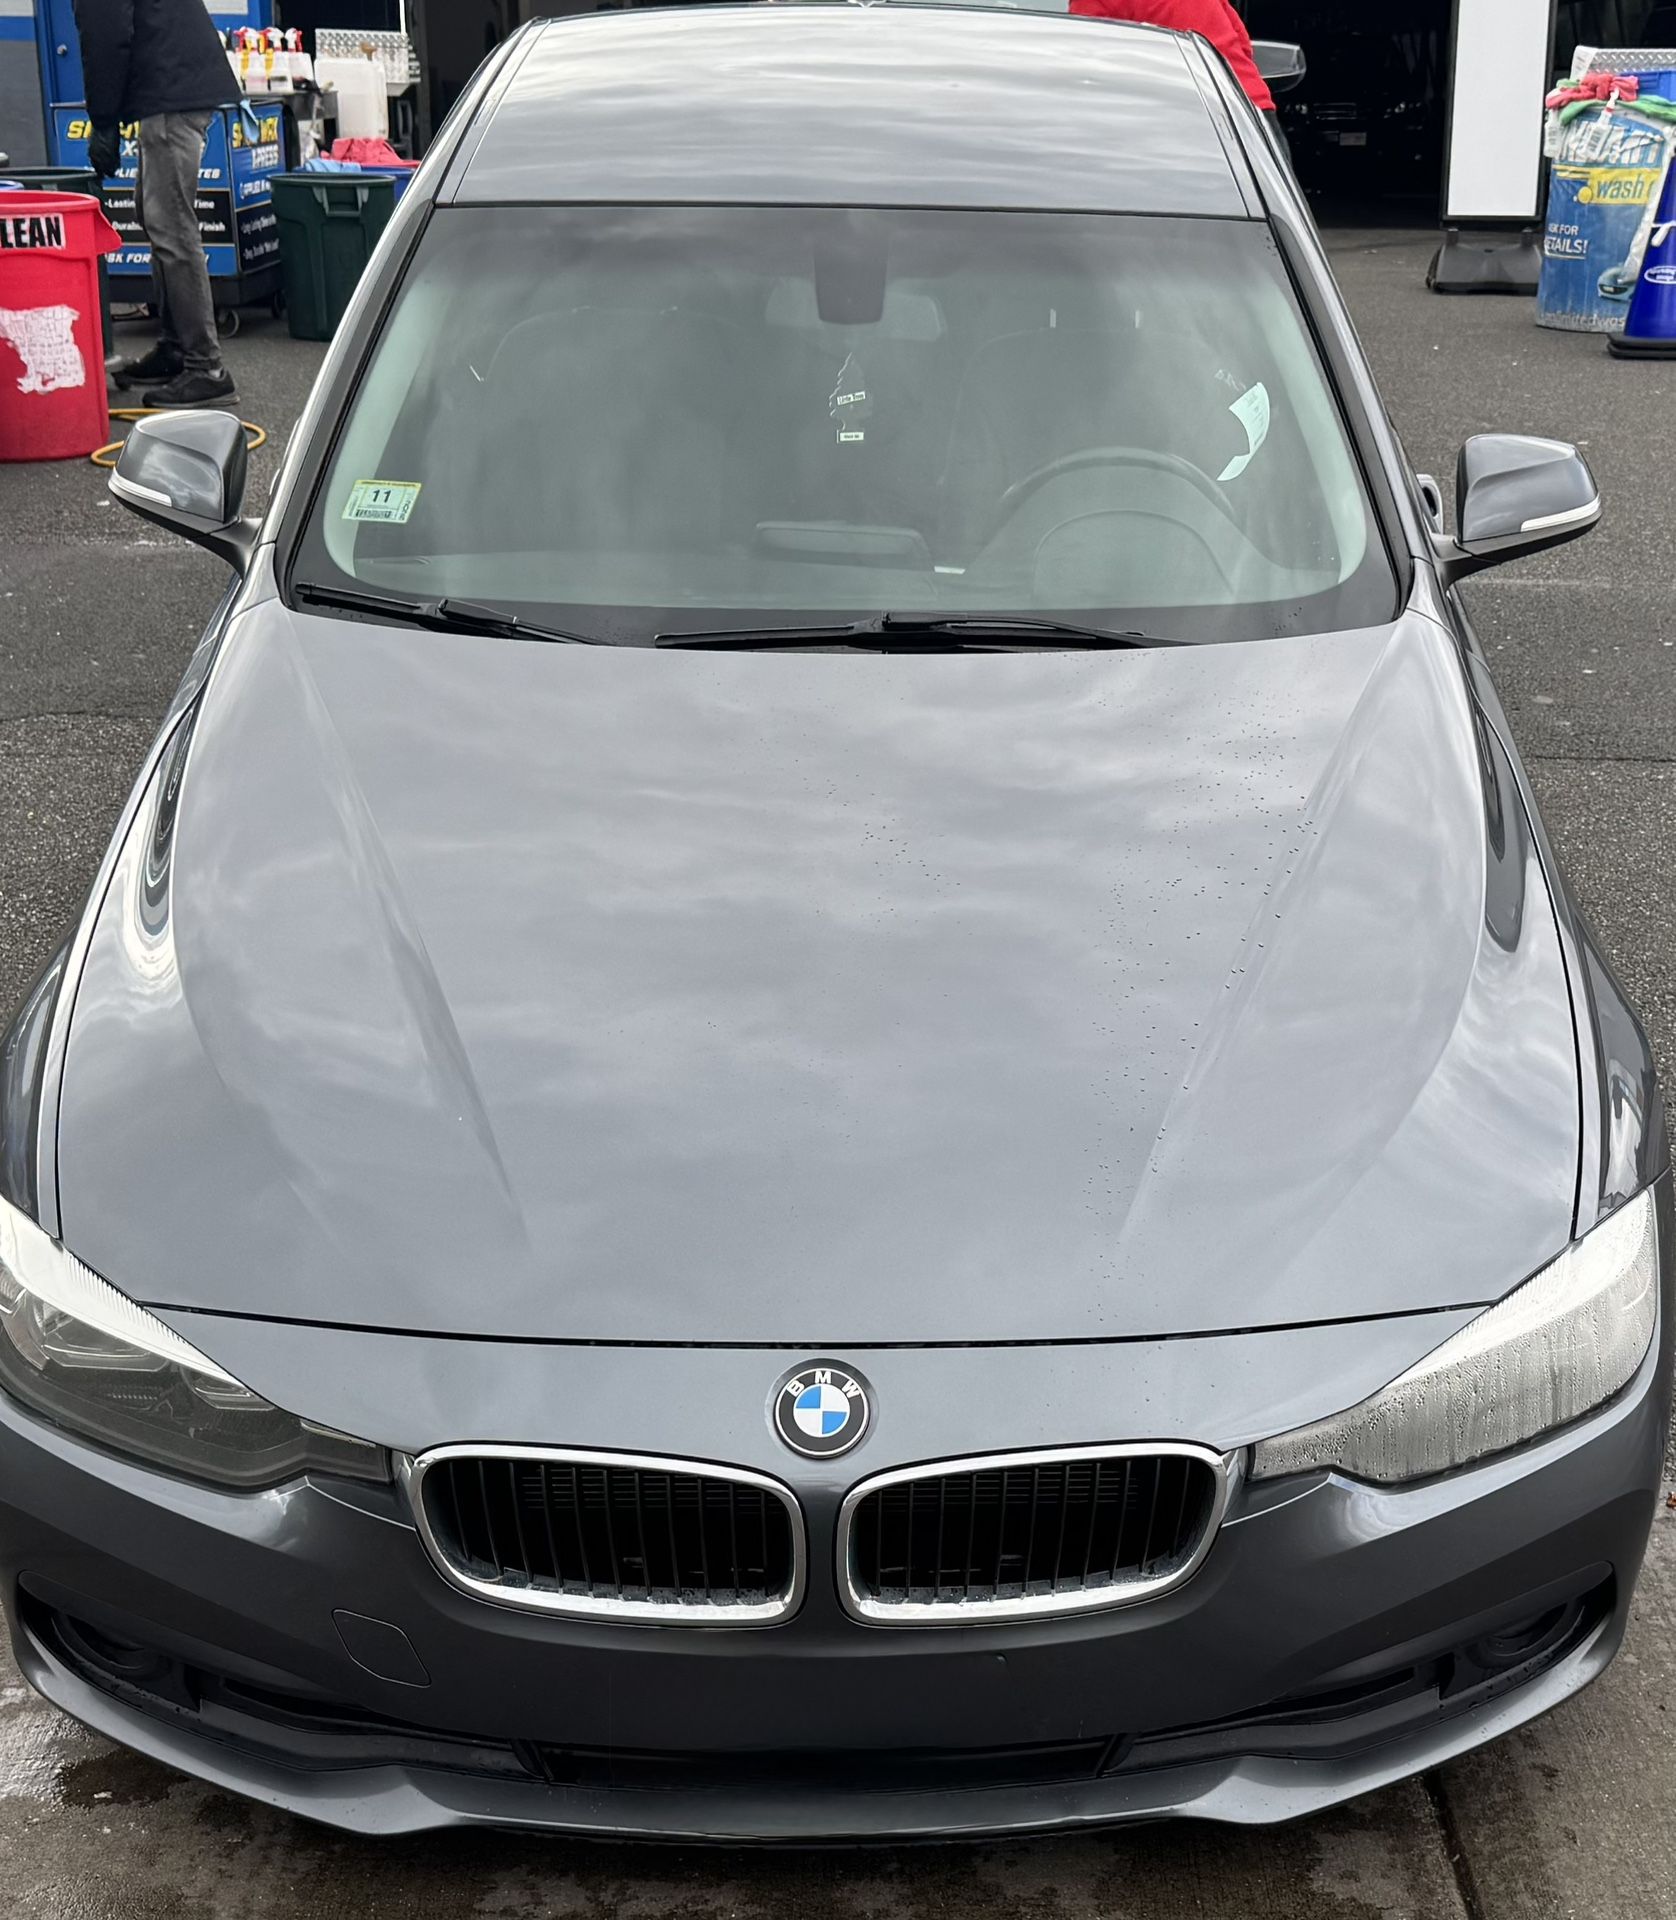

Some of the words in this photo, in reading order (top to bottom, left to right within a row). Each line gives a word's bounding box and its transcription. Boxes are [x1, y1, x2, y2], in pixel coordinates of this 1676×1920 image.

[1596, 172, 1644, 200] wash
[1557, 224, 1579, 236] FOR
[373, 489, 392, 503] 11
[786, 1370, 862, 1399] BMW
